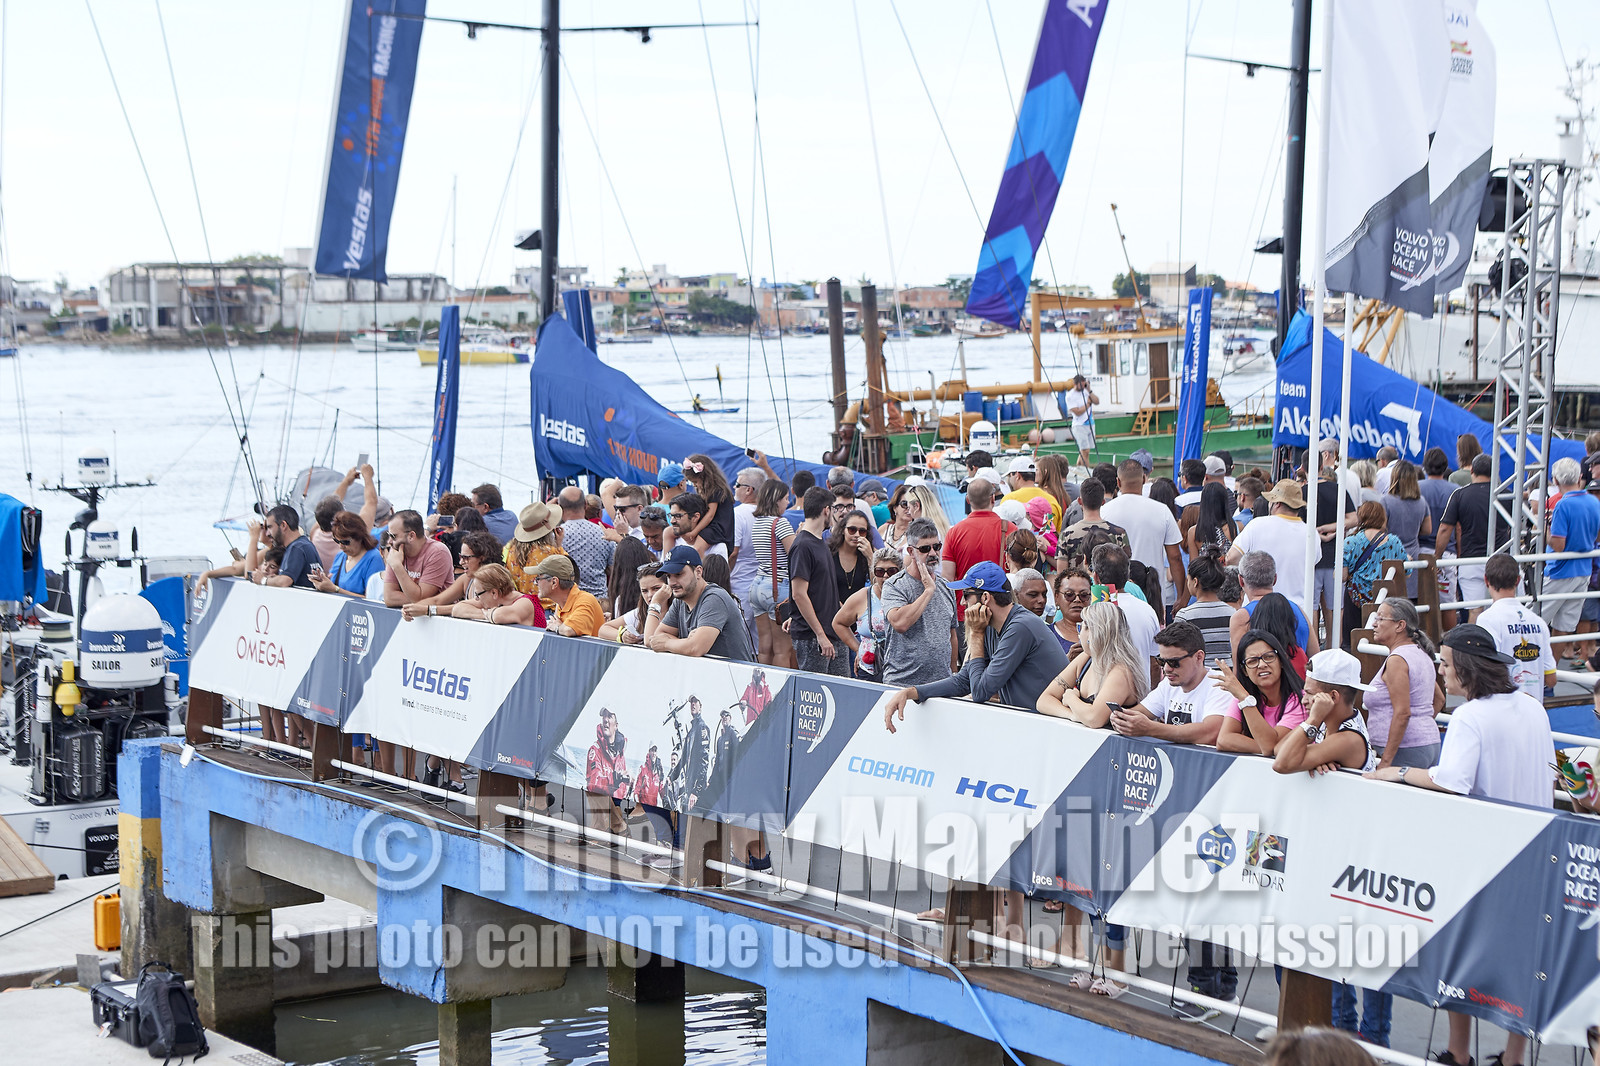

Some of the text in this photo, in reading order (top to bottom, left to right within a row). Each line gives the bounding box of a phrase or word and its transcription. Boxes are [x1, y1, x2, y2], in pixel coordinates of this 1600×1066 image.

[372, 15, 397, 76] RACING
[343, 186, 373, 271] Vestas
[1396, 226, 1429, 248] VOLVO
[1393, 240, 1428, 262] OCEAN
[1391, 254, 1415, 273] RACE
[1280, 379, 1306, 398] team
[540, 413, 586, 447] Vestas
[628, 447, 658, 475] HOUR
[352, 614, 367, 625] VOLVO
[351, 636, 363, 647] RACE
[352, 625, 367, 637] OCEAN
[236, 635, 286, 670] OMEGA
[92, 660, 120, 671] SAILOR
[402, 658, 471, 701] Vestas
[800, 690, 822, 704] VOLVO
[799, 704, 823, 718] OCEAN
[798, 717, 816, 731] RACE
[497, 752, 533, 768] Race Partner
[1127, 752, 1157, 770] VOLVO
[848, 756, 935, 788] COBHAM
[1125, 768, 1157, 786] OCEAN
[955, 777, 1037, 809] HCL
[1124, 784, 1148, 801] RACE
[1055, 875, 1094, 899] Sponsors
[1241, 867, 1284, 892] PINDAR
[1332, 864, 1436, 912] MUSTO
[1564, 880, 1597, 902] RACE
[1437, 979, 1524, 1018] Race Sponsors
